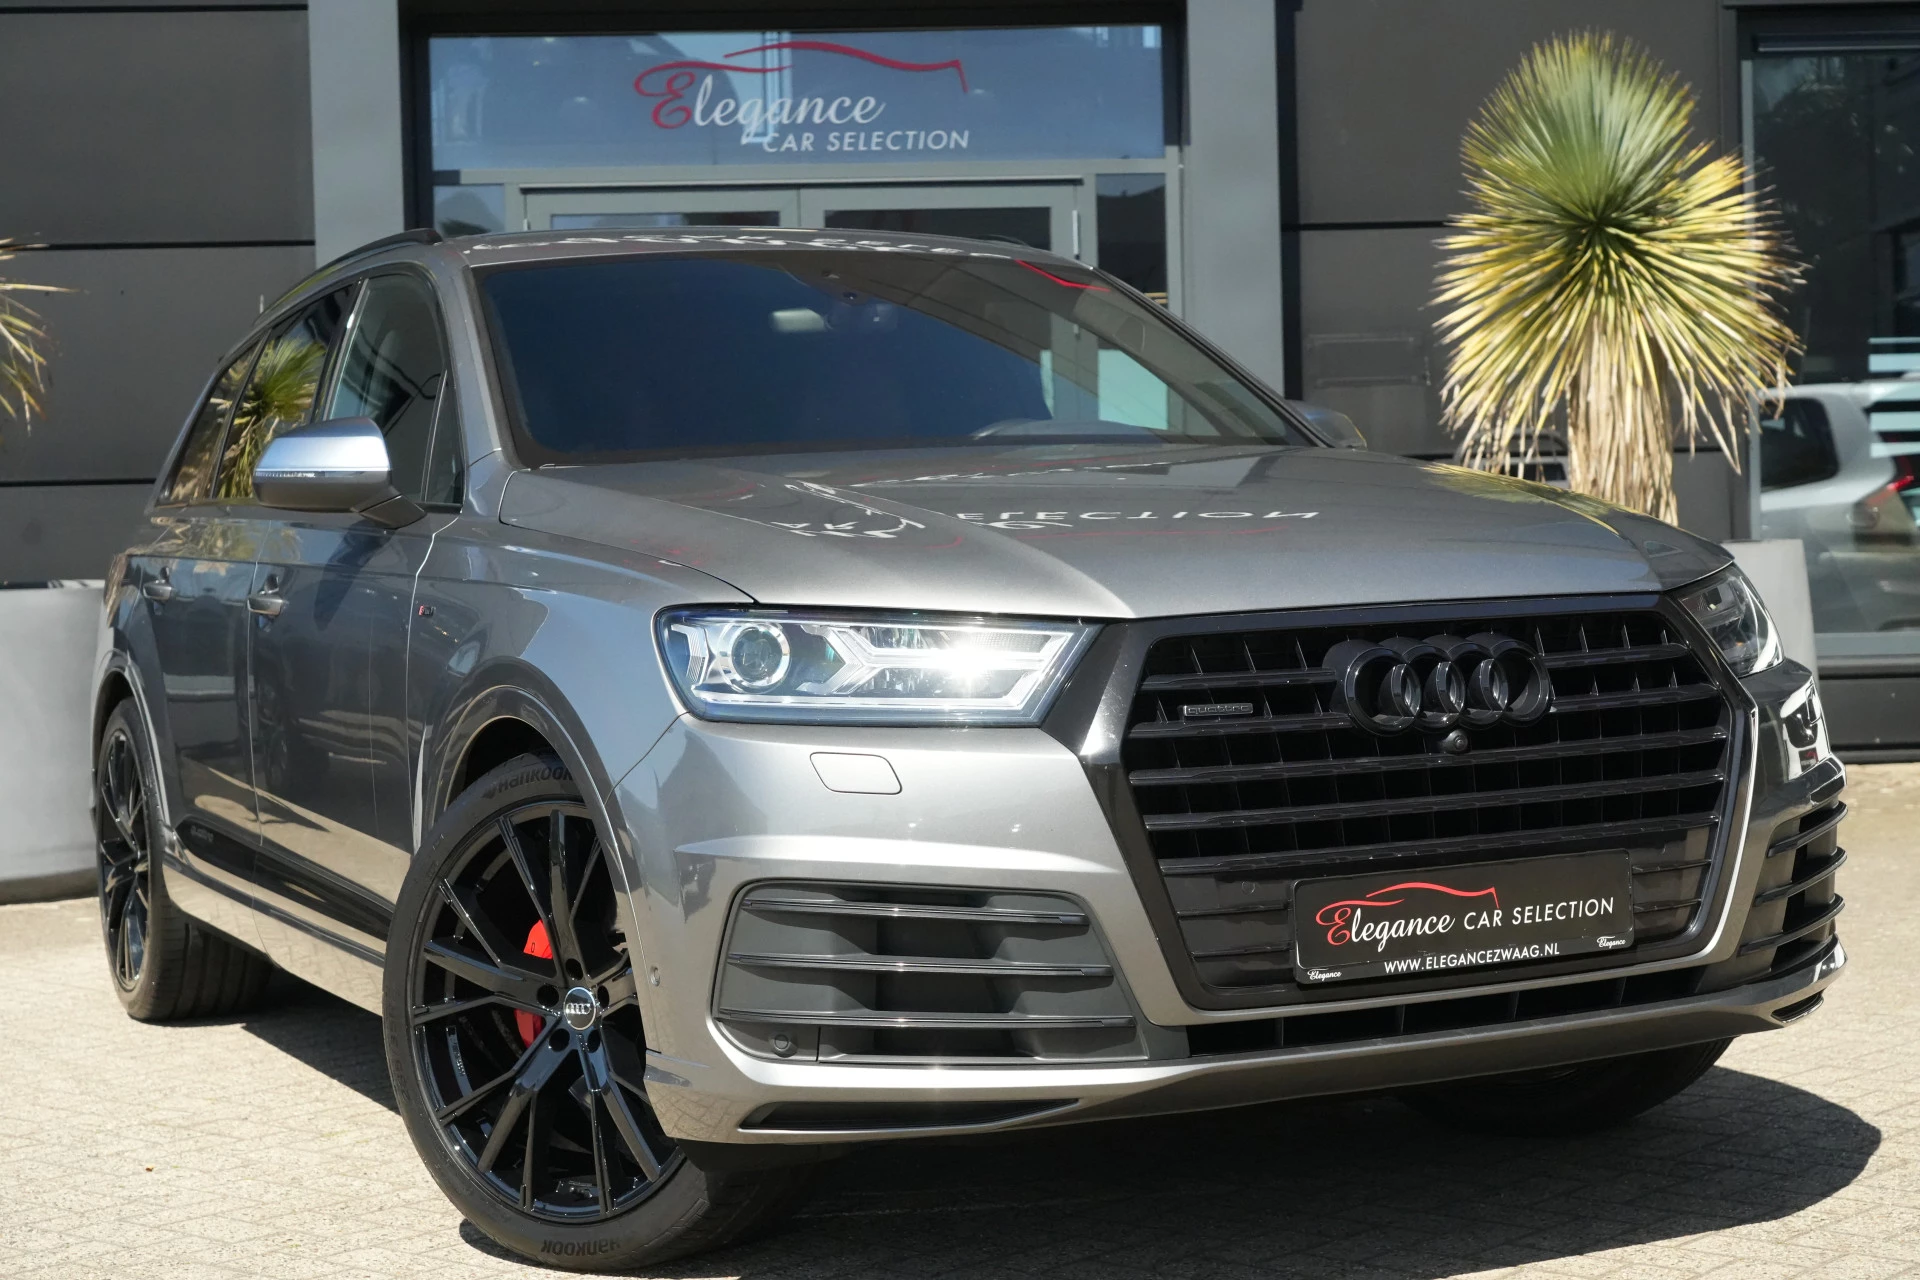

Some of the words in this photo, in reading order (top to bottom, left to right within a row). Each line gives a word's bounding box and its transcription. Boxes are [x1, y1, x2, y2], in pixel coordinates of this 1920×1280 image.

[634, 61, 886, 146] Elegance
[762, 132, 814, 152] CAR
[826, 130, 969, 151] SELECTION
[1315, 899, 1456, 953] Elegance
[1463, 908, 1503, 931] CAR
[1512, 897, 1615, 927] SELECTION
[1384, 942, 1560, 974] WWW.ELEGANCEZWAAG.NL
